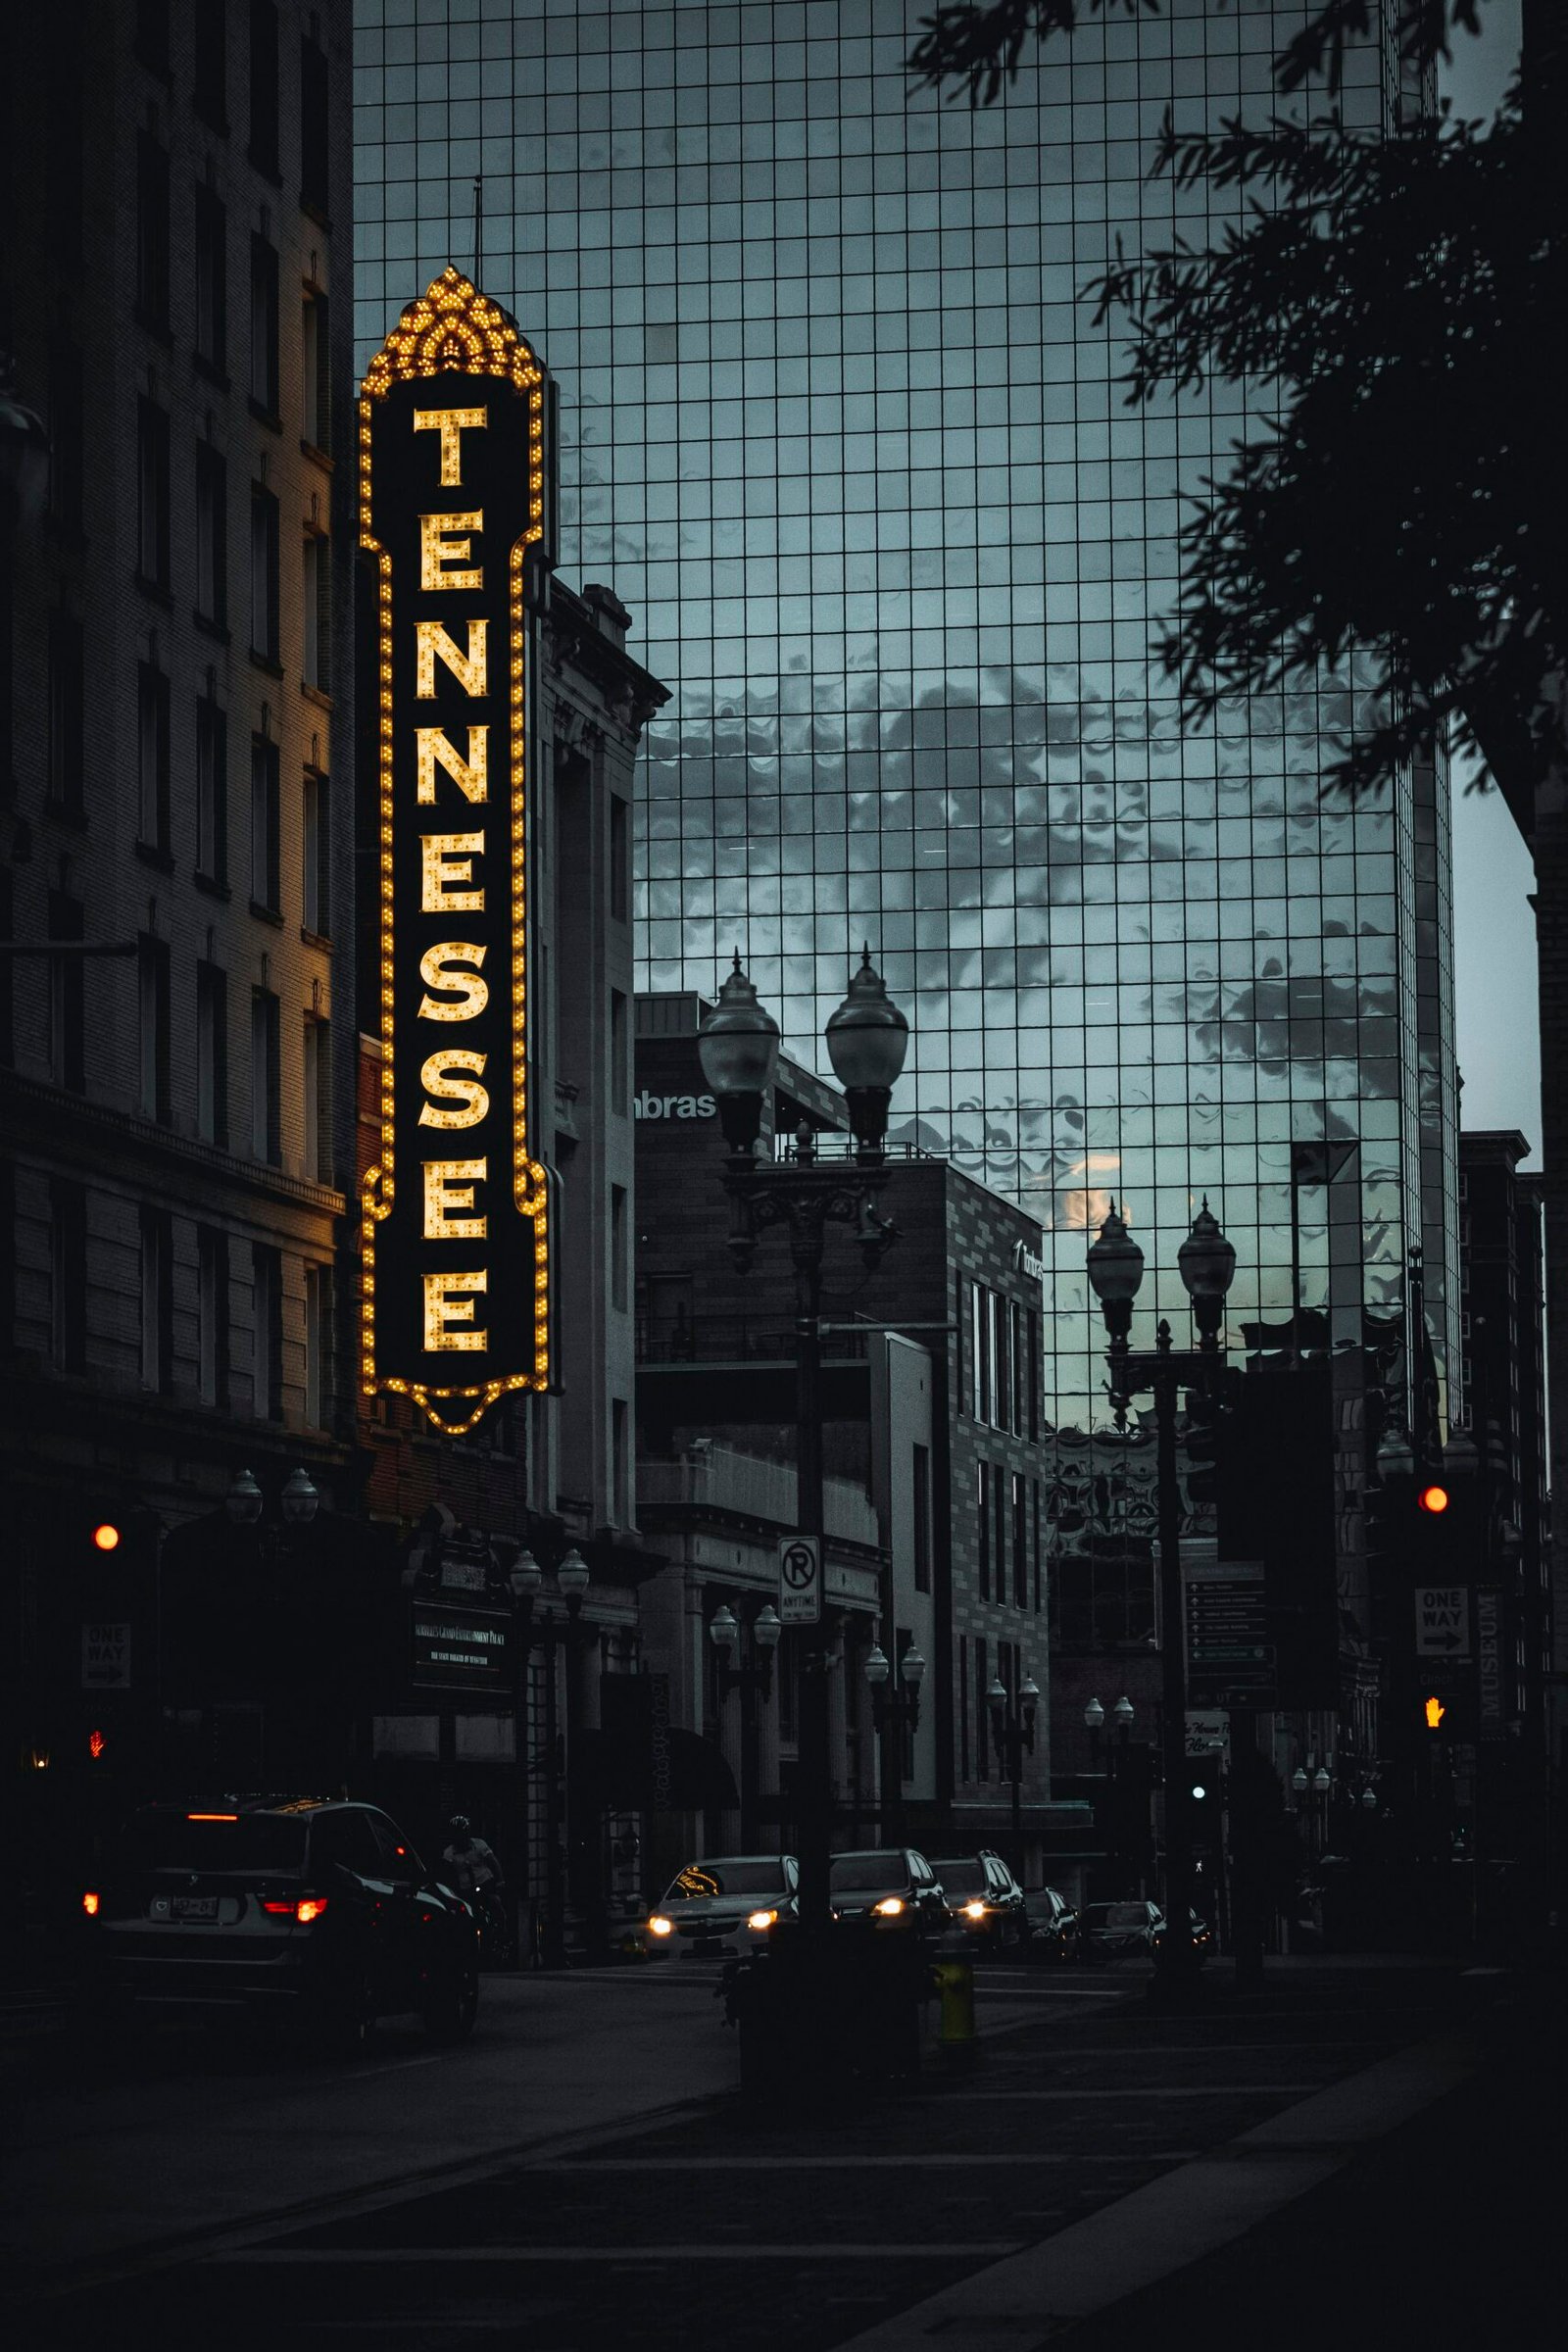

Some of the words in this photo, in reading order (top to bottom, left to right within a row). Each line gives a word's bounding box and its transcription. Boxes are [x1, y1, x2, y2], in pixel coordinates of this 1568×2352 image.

[413, 405, 493, 1353] TENNESSEE
[784, 1595, 816, 1608] ANYTIME
[1423, 1592, 1461, 1608] ONE
[1423, 1610, 1462, 1627] WAY
[89, 1629, 125, 1643] ONE
[88, 1645, 125, 1660] WAY
[1478, 1593, 1500, 1718] MUSEUM
[1216, 1693, 1232, 1704] UT
